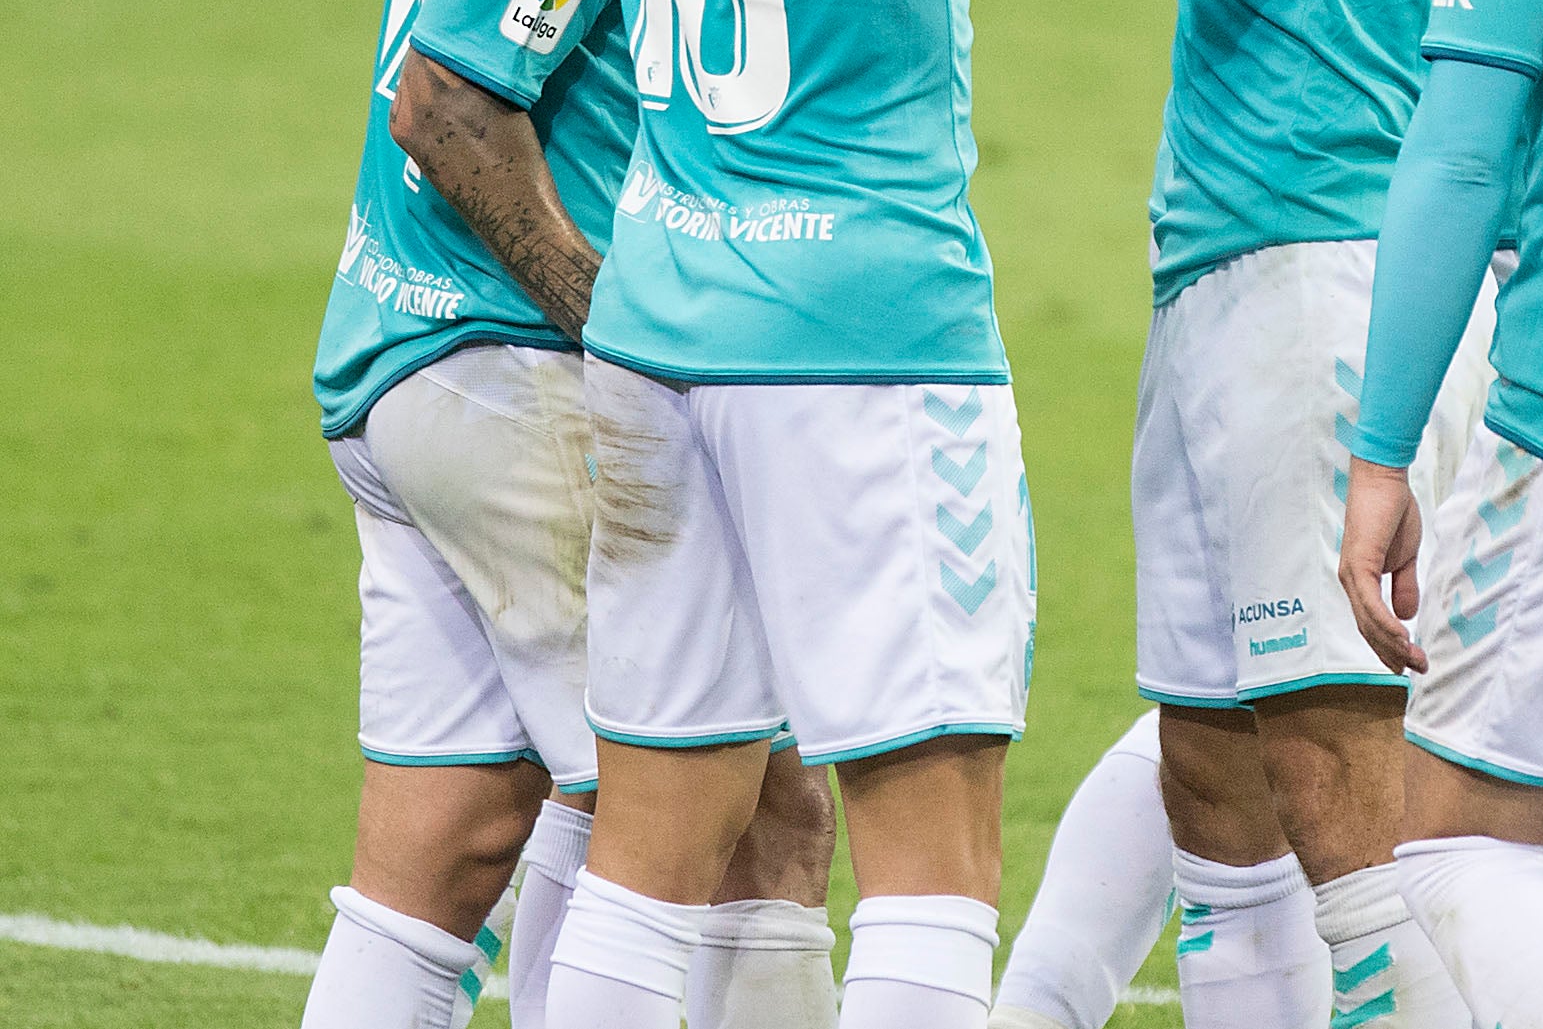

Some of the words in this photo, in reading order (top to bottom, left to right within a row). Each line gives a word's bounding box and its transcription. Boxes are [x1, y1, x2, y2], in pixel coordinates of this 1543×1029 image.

[759, 198, 810, 217] OBRAS
[729, 212, 835, 243] VICENTE
[406, 267, 453, 290] OBRAS
[1239, 597, 1305, 624] ACUNSA
[1249, 627, 1307, 657] hummel
